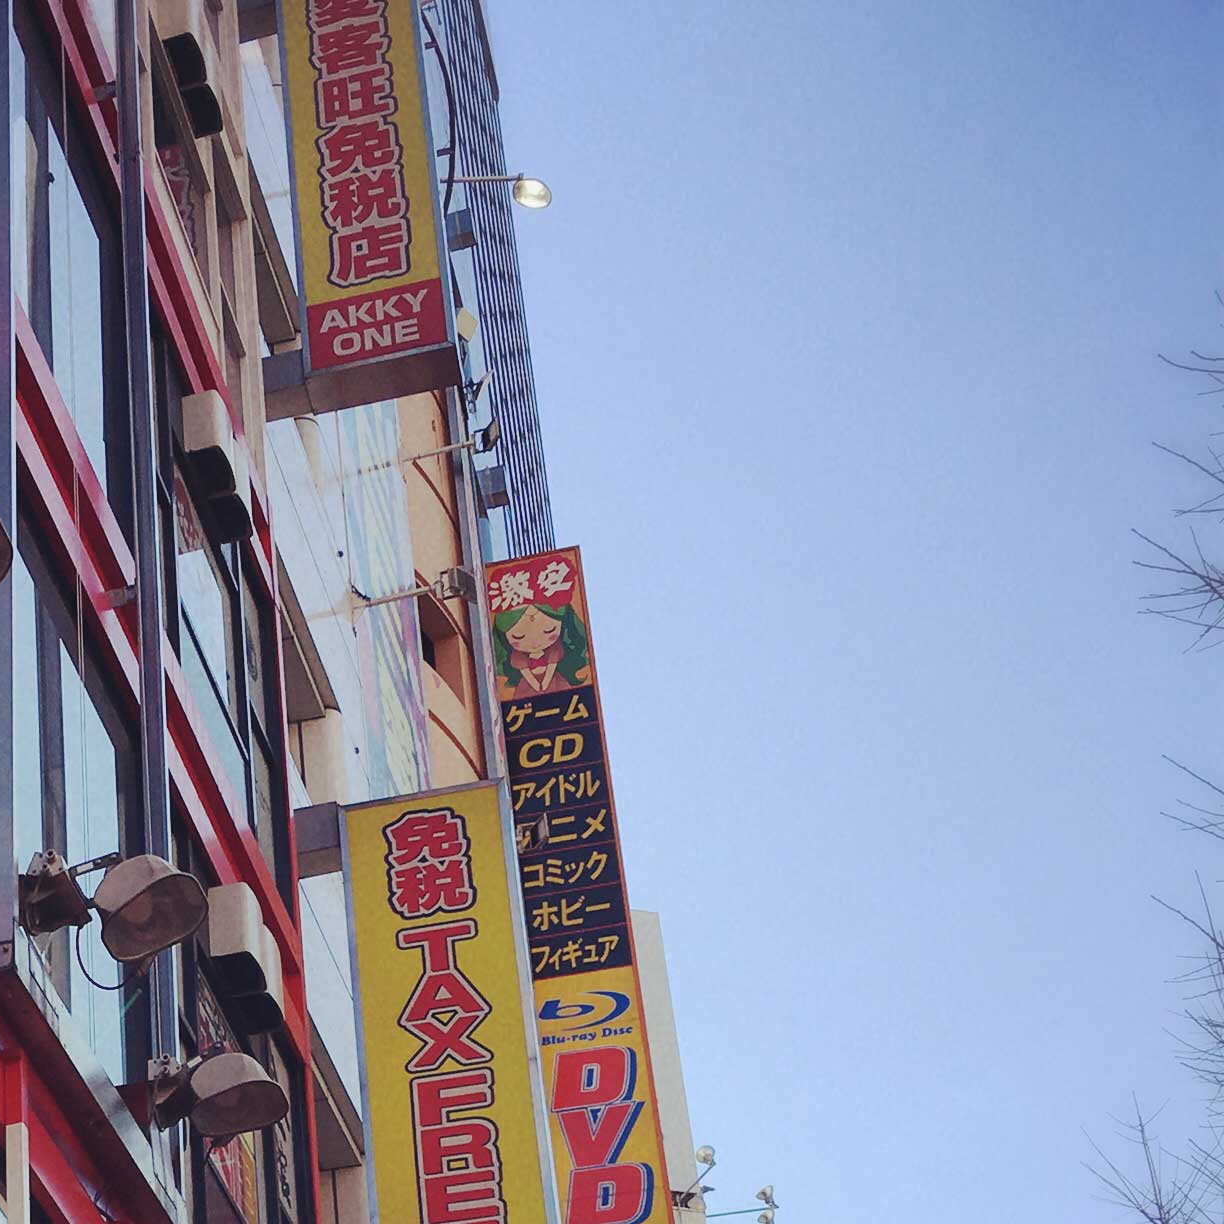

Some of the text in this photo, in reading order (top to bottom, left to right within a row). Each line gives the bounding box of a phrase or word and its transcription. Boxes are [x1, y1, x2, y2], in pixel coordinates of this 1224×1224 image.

[320, 288, 428, 334] AKKY
[332, 319, 421, 357] ONE
[488, 560, 576, 612] 激安
[506, 694, 589, 732] ゲーム
[519, 733, 584, 769] CD
[513, 770, 600, 811] アイドル
[521, 809, 607, 850] ニメ
[385, 807, 474, 920] 免税
[523, 850, 608, 889] コミック
[531, 897, 611, 932] ホビー
[531, 935, 620, 974] フィギュア
[396, 917, 493, 1076] TAX
[541, 1025, 634, 1047] Blu-ray Disc
